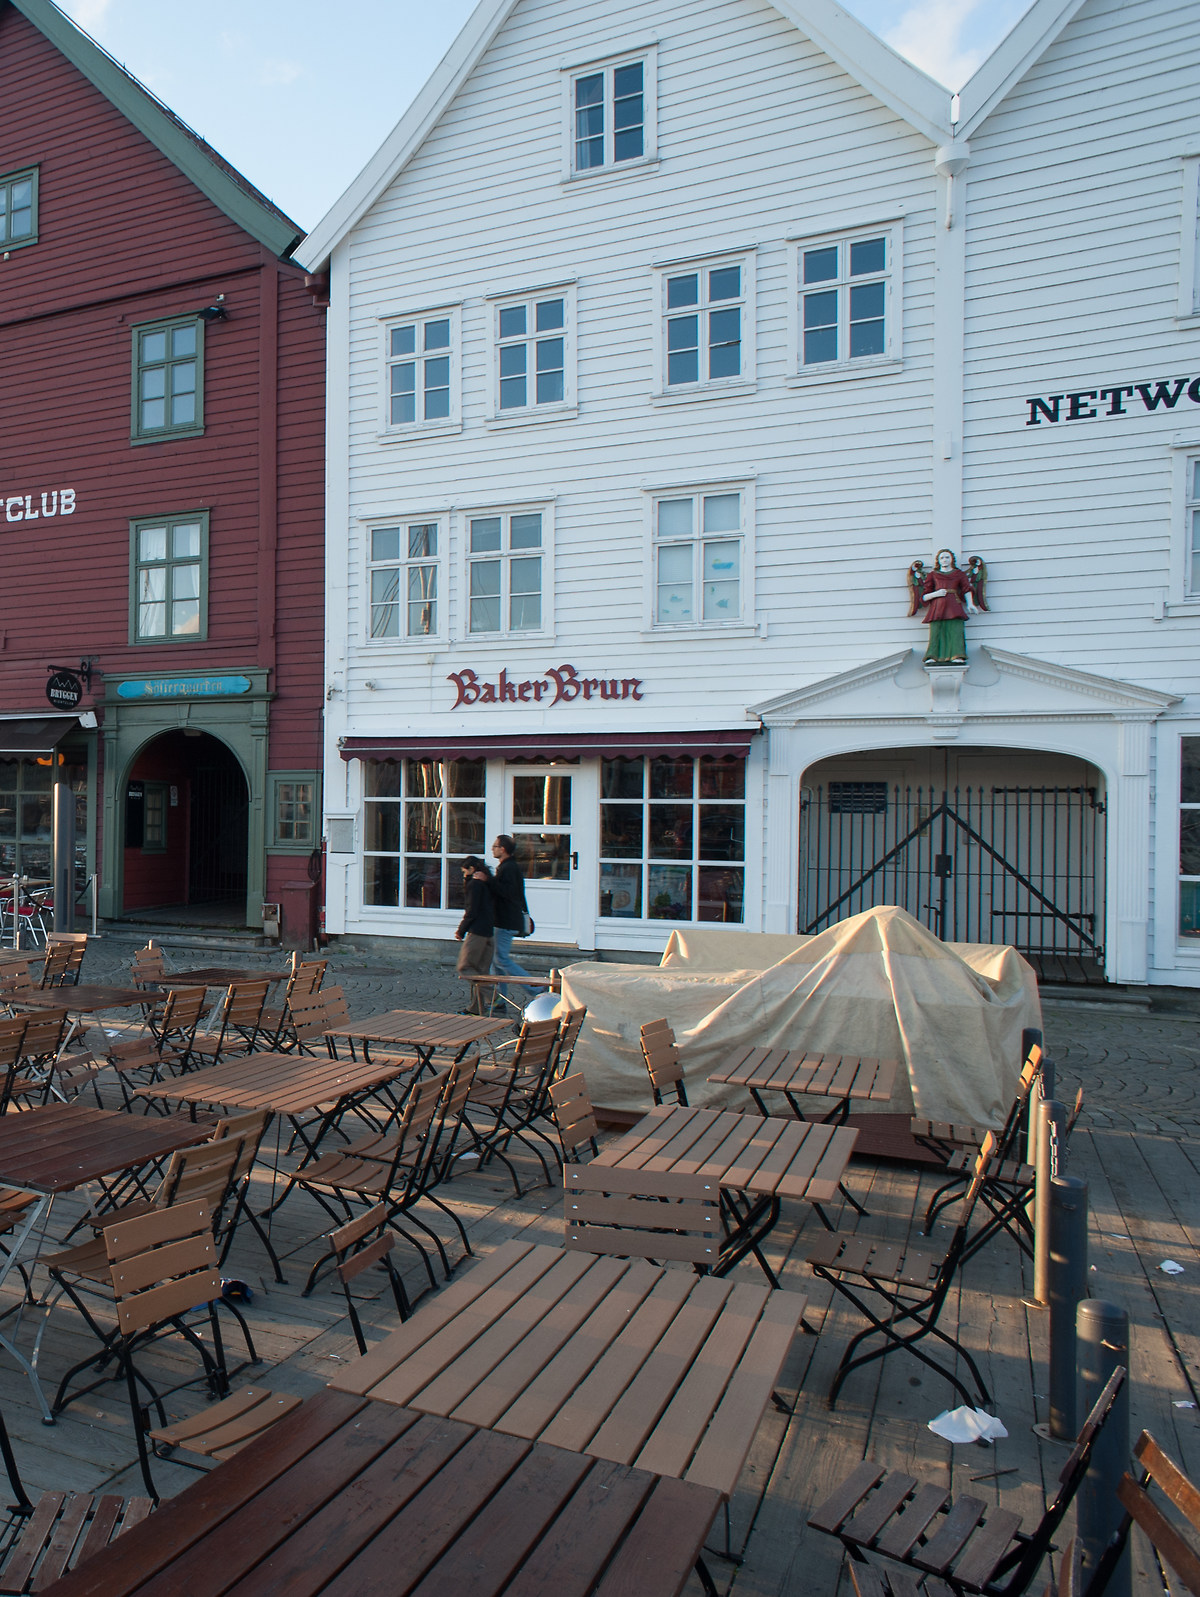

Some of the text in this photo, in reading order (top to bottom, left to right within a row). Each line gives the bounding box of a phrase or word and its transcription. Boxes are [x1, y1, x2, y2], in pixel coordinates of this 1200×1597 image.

[50, 688, 78, 701] BRYGGEN
[446, 664, 644, 710] Baker Brun
